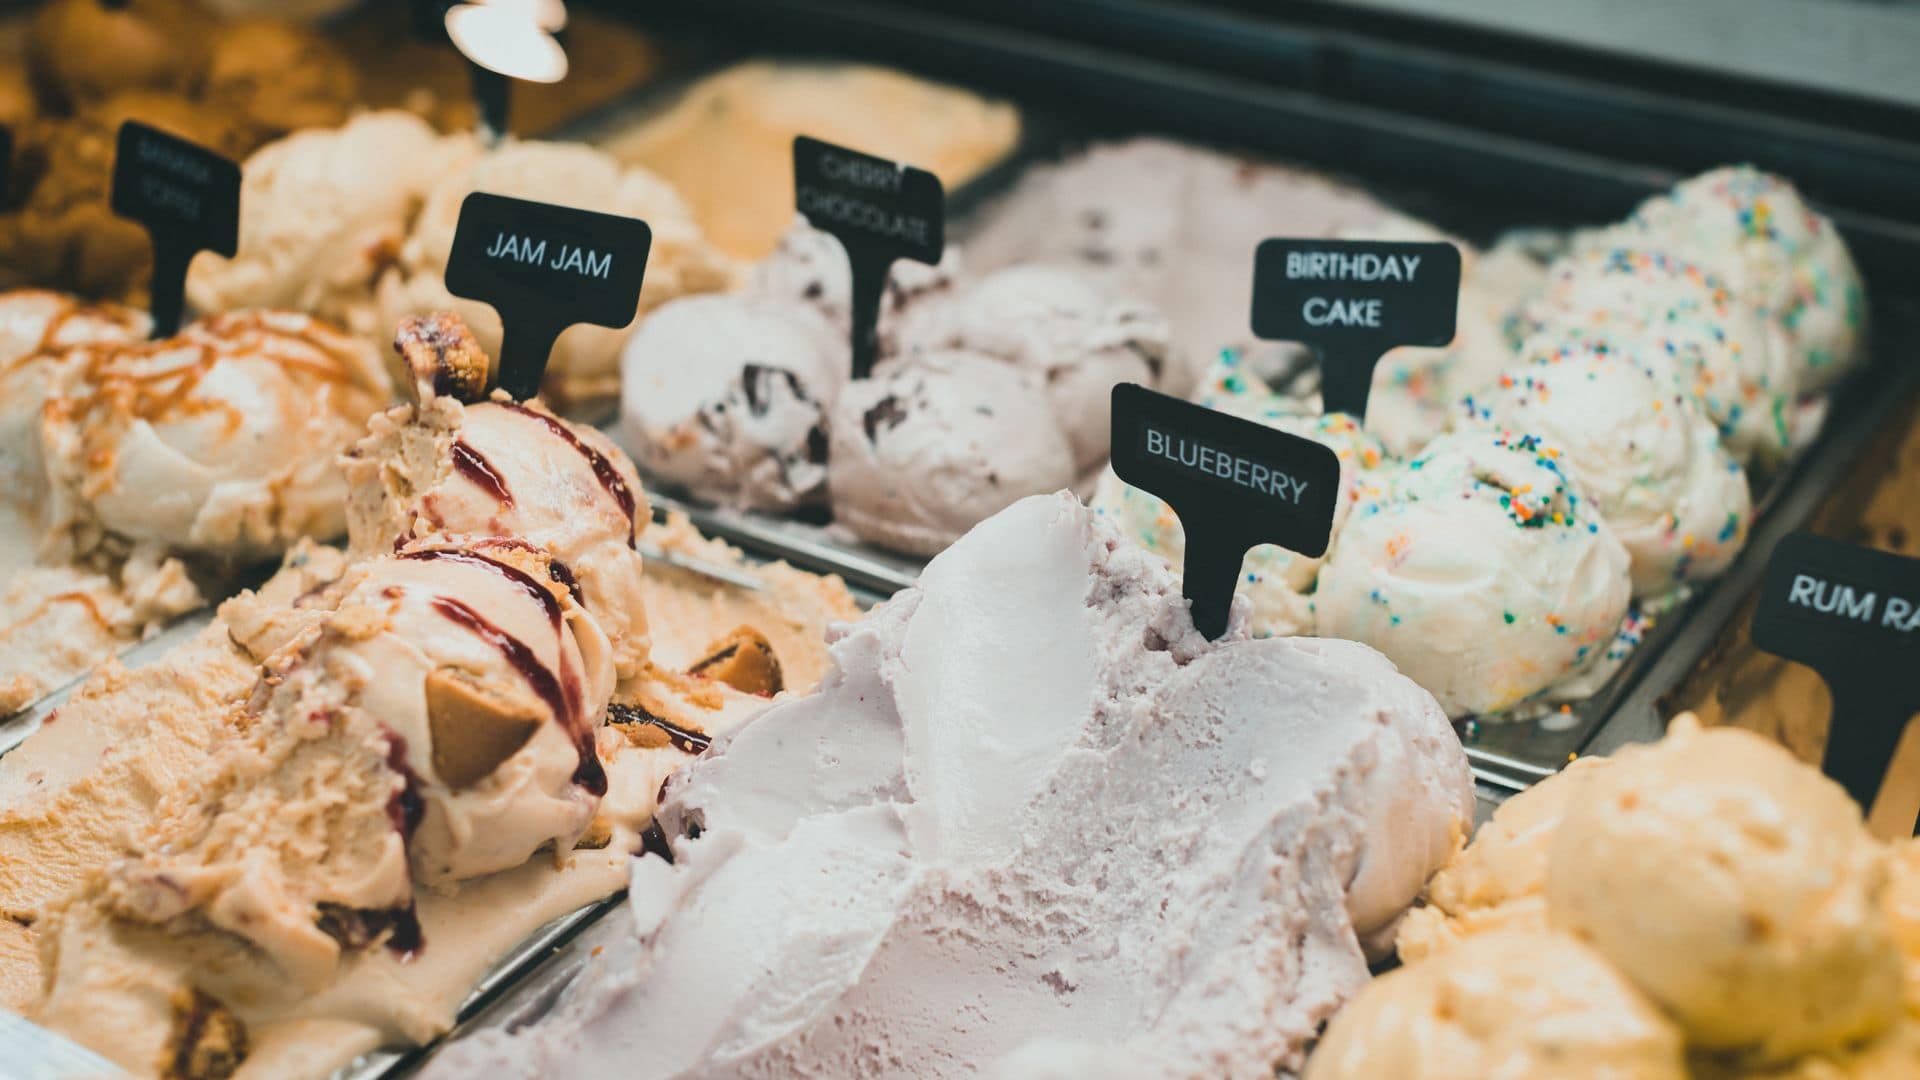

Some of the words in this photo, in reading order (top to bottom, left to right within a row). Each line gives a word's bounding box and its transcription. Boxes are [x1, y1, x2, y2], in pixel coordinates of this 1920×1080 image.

[819, 152, 901, 191] CHERRY
[799, 185, 928, 245] CHOCOLATE
[487, 232, 547, 266] JAM
[550, 245, 613, 280] JAM
[1286, 252, 1420, 281] BIRTHDAY
[1302, 296, 1383, 328] CAKE
[1147, 429, 1308, 505] BLUEBERRY
[1788, 574, 1877, 622] RUM
